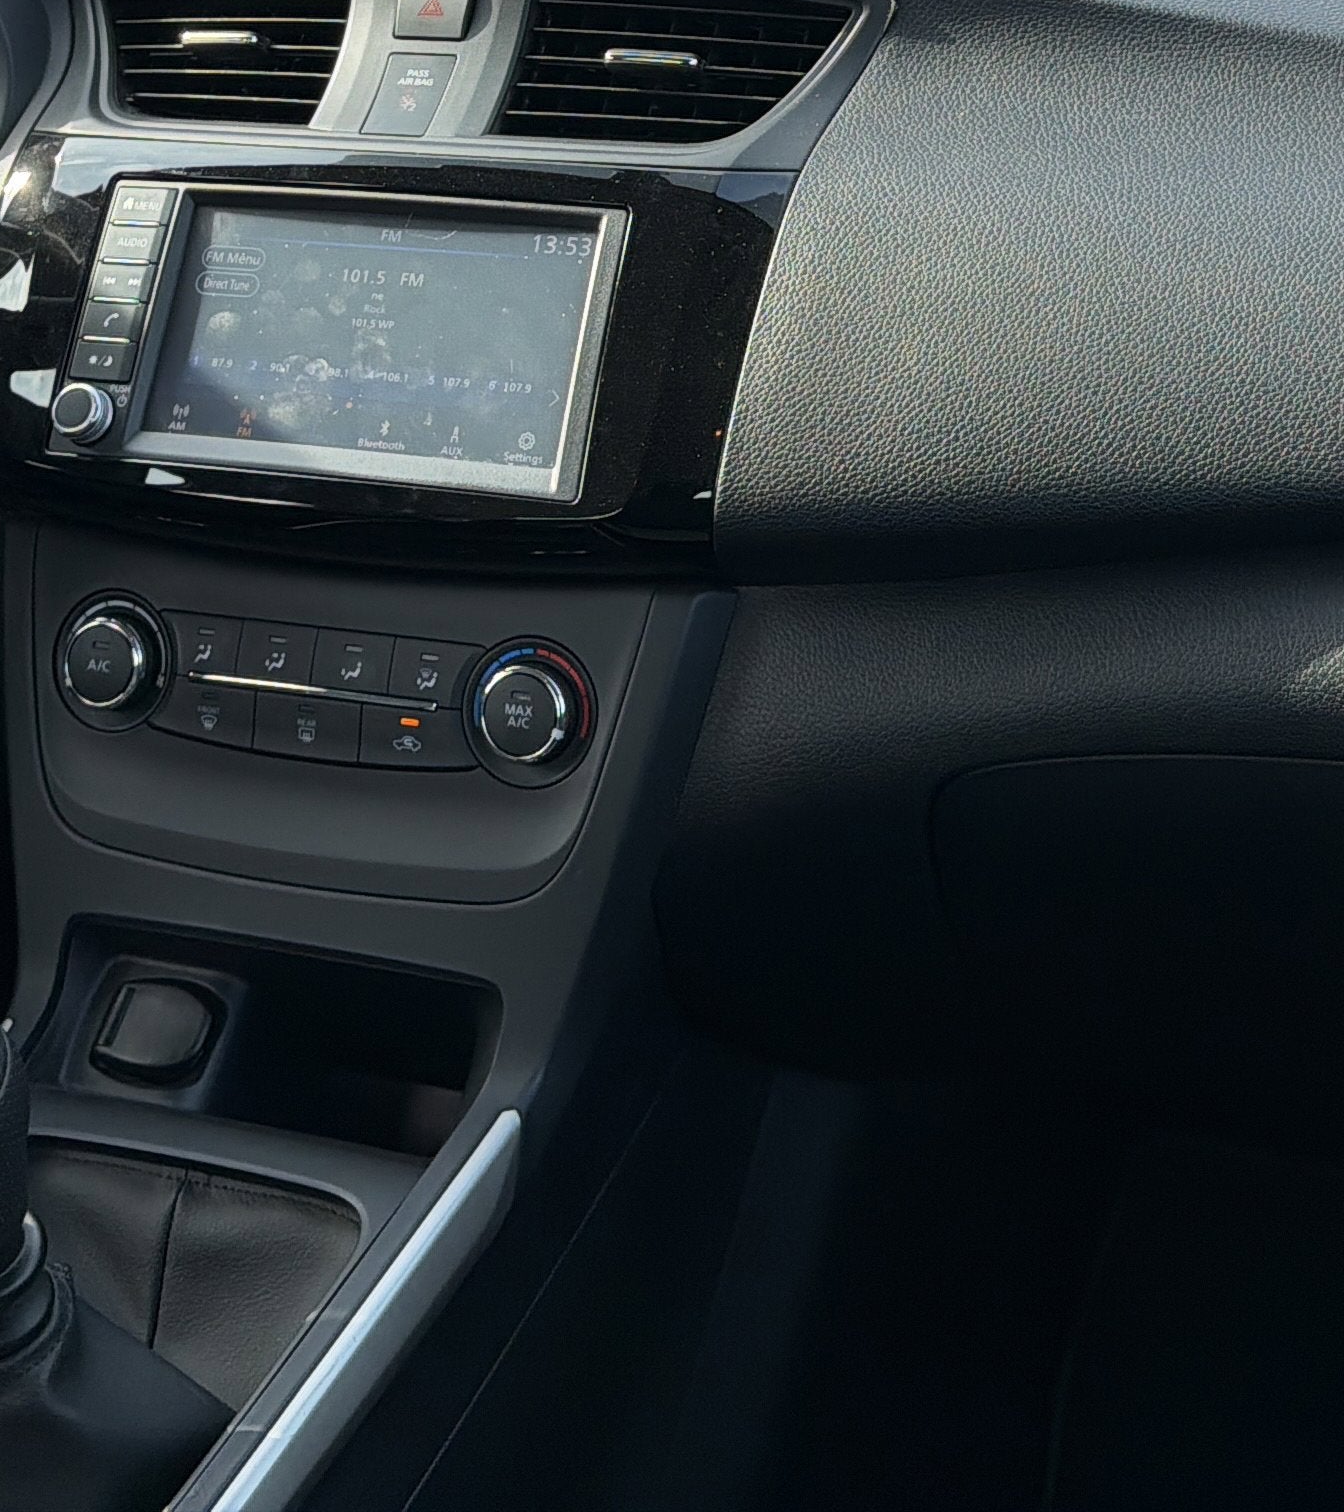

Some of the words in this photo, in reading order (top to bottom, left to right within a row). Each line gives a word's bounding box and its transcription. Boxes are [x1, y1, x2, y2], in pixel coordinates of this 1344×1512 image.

[406, 68, 431, 78] PASS
[134, 199, 162, 211] MENU
[117, 236, 149, 248] AUDIO
[381, 228, 403, 243] FM
[532, 233, 593, 258] 13:53
[205, 249, 225, 265] FM
[227, 251, 262, 266] Menu
[203, 276, 229, 290] Direct
[229, 278, 250, 291] Tune
[341, 268, 387, 285] 101.5
[399, 271, 425, 288] FM
[363, 303, 386, 314] Rock
[351, 317, 376, 329] 101.5
[210, 357, 234, 370] 87.9
[382, 371, 409, 384] 106.1
[443, 376, 471, 389] 107.9
[503, 381, 533, 394] 107.9
[109, 383, 132, 394] PUSH
[166, 420, 187, 433] AM
[236, 427, 253, 438] FM
[356, 438, 406, 452] Bluetooth
[439, 445, 464, 457] AUX
[503, 451, 544, 467] Settings
[87, 658, 111, 674] A/C
[196, 704, 221, 714] FRONT
[504, 702, 534, 717] MAX
[296, 717, 317, 727] REAR
[506, 715, 531, 730] A/C
